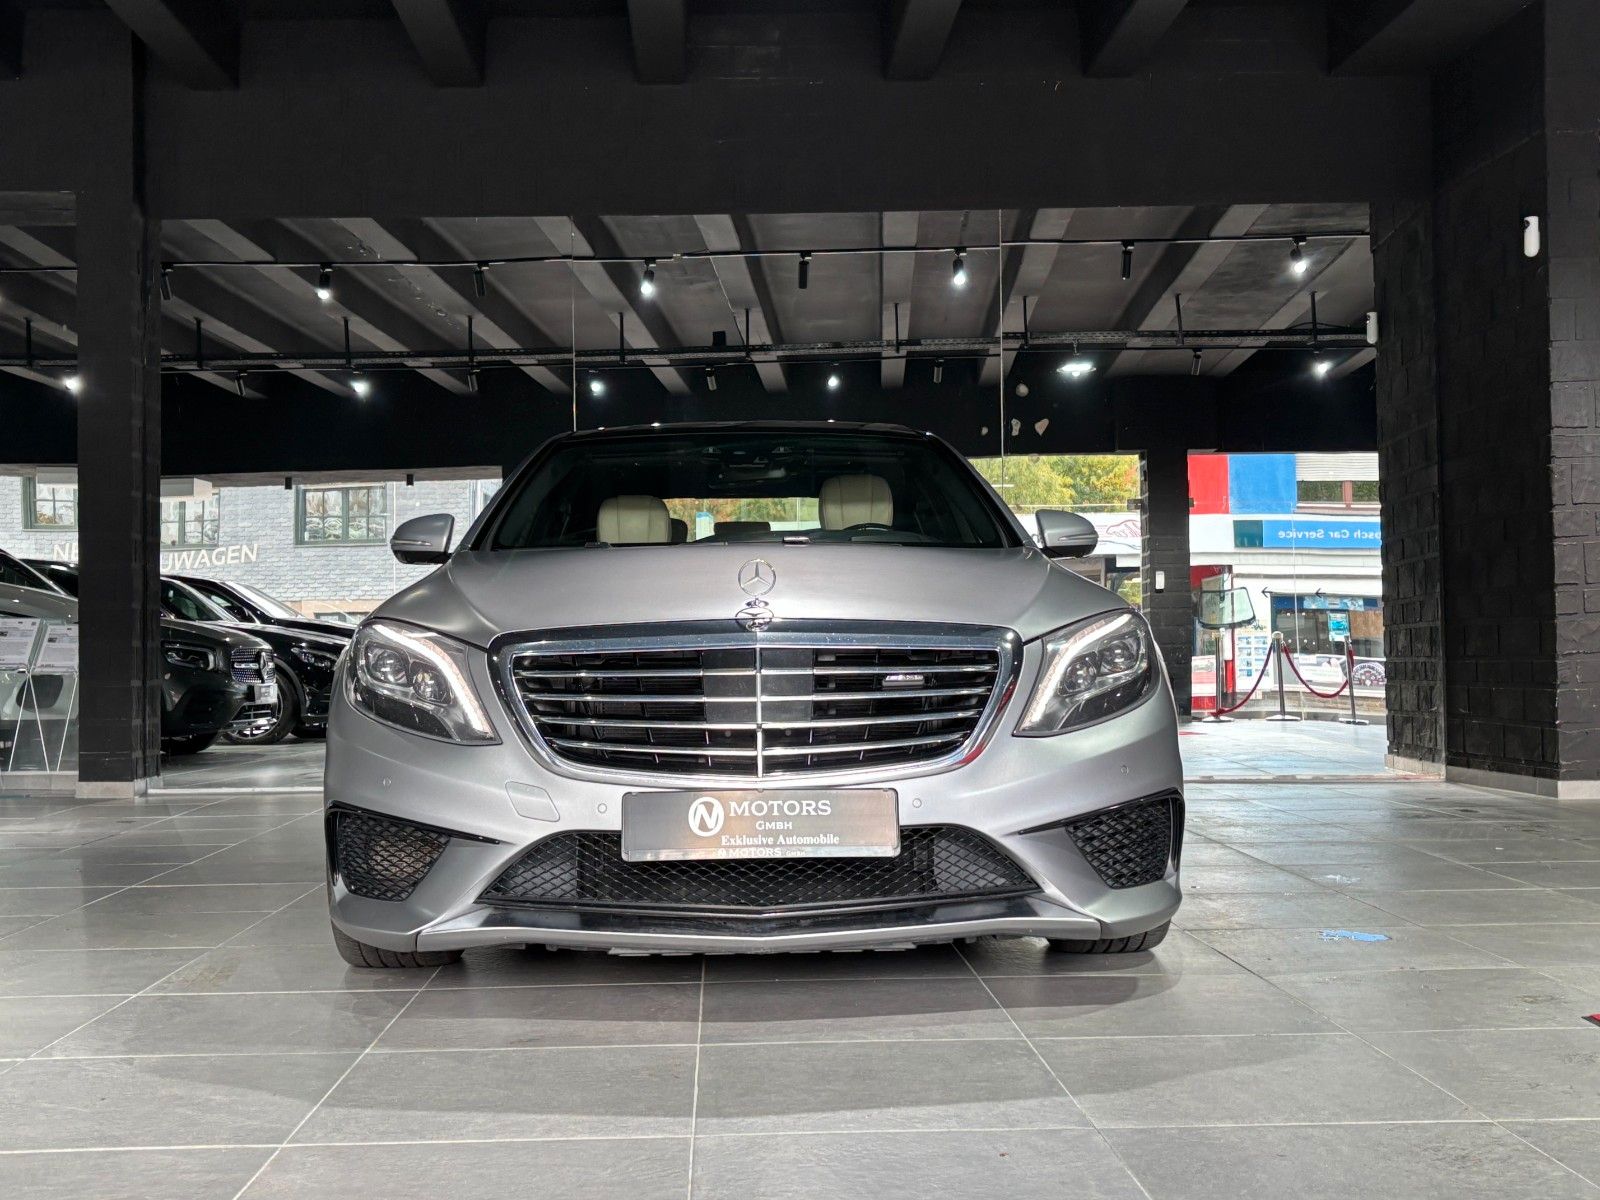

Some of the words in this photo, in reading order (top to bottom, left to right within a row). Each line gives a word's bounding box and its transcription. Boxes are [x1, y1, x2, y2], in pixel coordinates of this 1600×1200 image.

[729, 799, 832, 817] MOTORS
[755, 820, 793, 830] GMBH
[721, 834, 774, 846] Exklusive
[776, 833, 839, 846] Automobile
[729, 847, 782, 857] MOTORS
